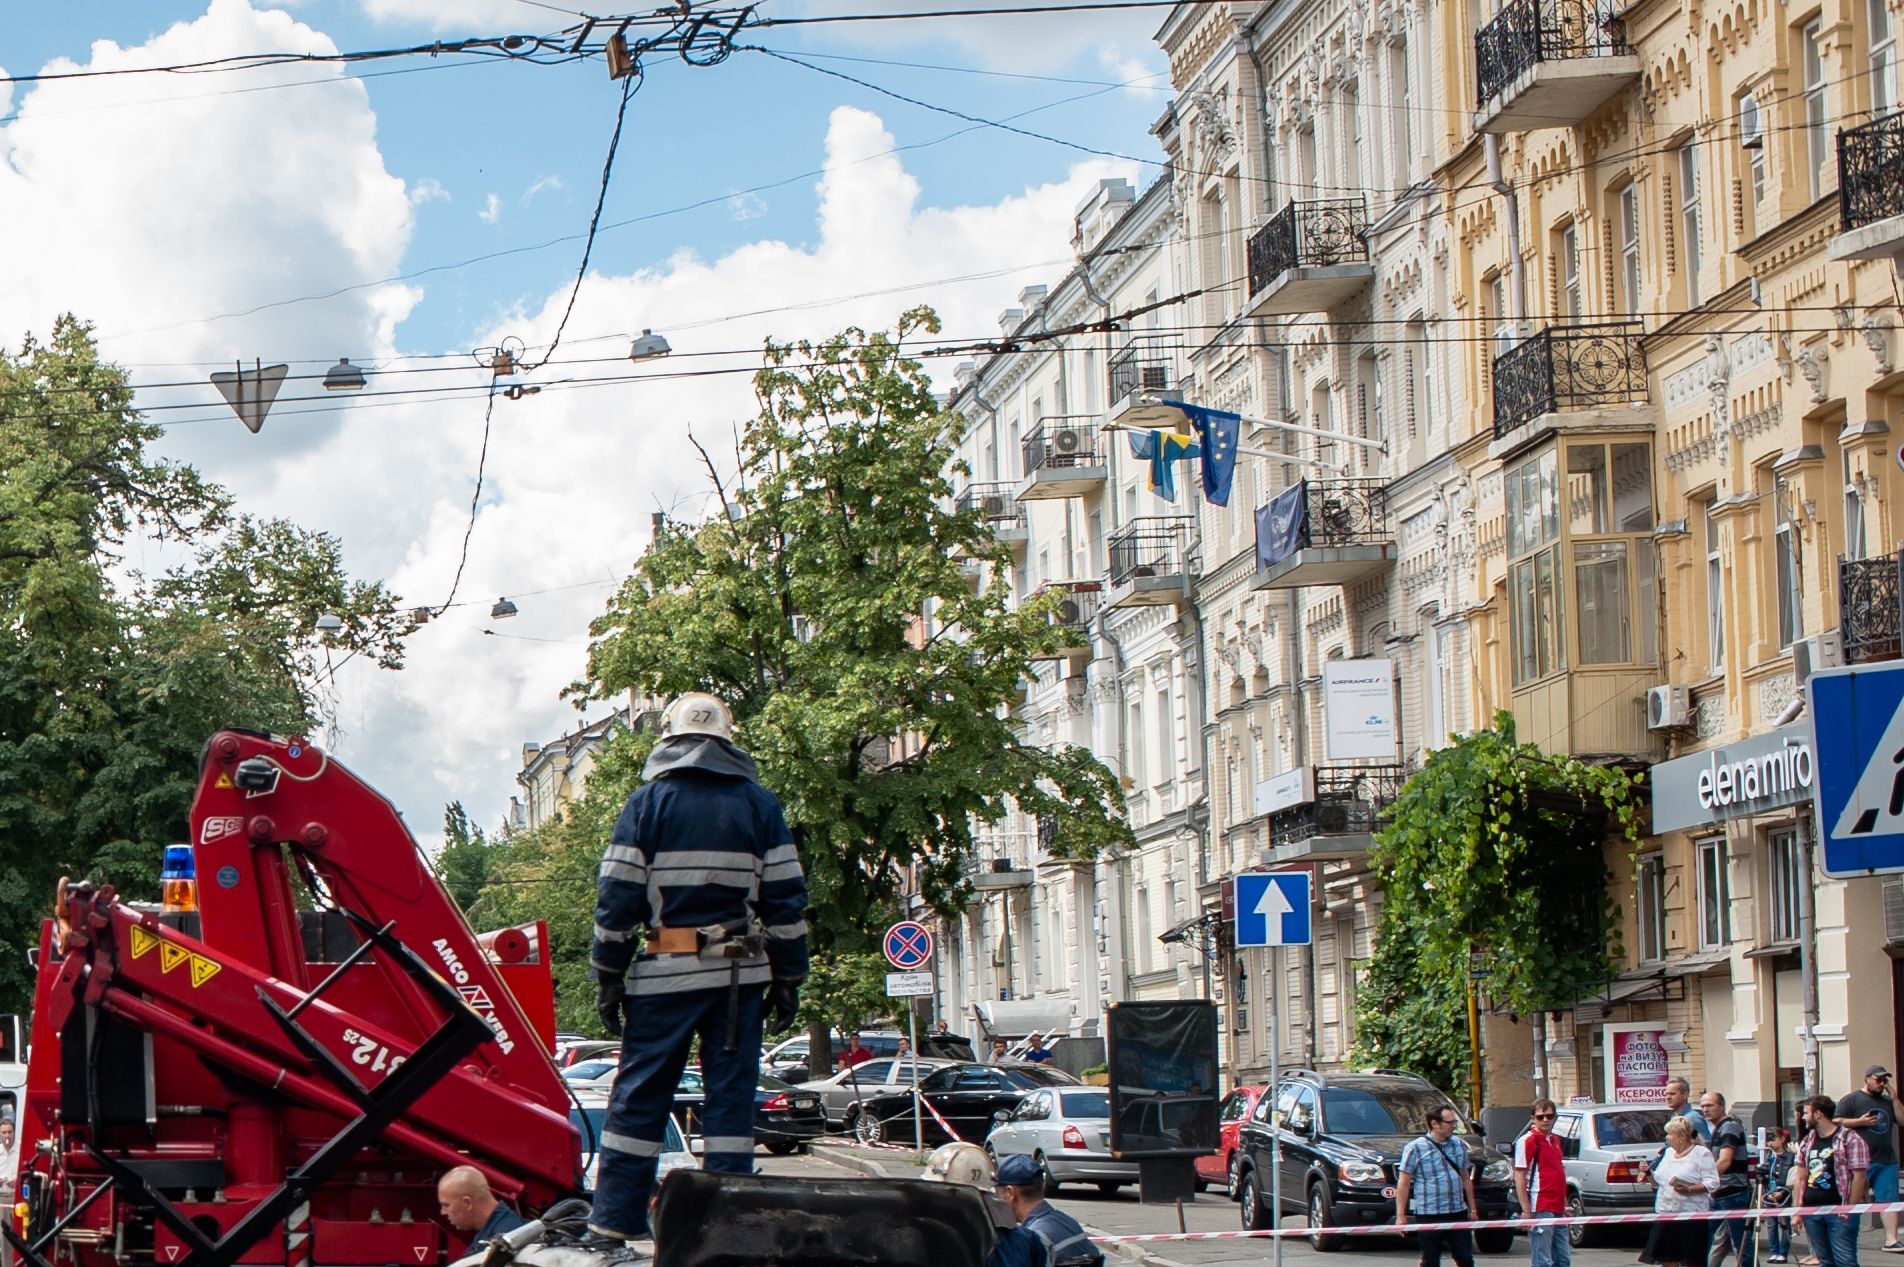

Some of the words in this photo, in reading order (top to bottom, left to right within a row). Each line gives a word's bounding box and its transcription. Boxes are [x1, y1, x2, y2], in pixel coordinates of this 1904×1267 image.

[691, 709, 713, 723] 27
[432, 938, 469, 984] AMCO
[485, 1011, 515, 1056] VEBA
[1626, 1042, 1657, 1051] ФОТО
[1617, 1060, 1669, 1071] ПАСПОРТ
